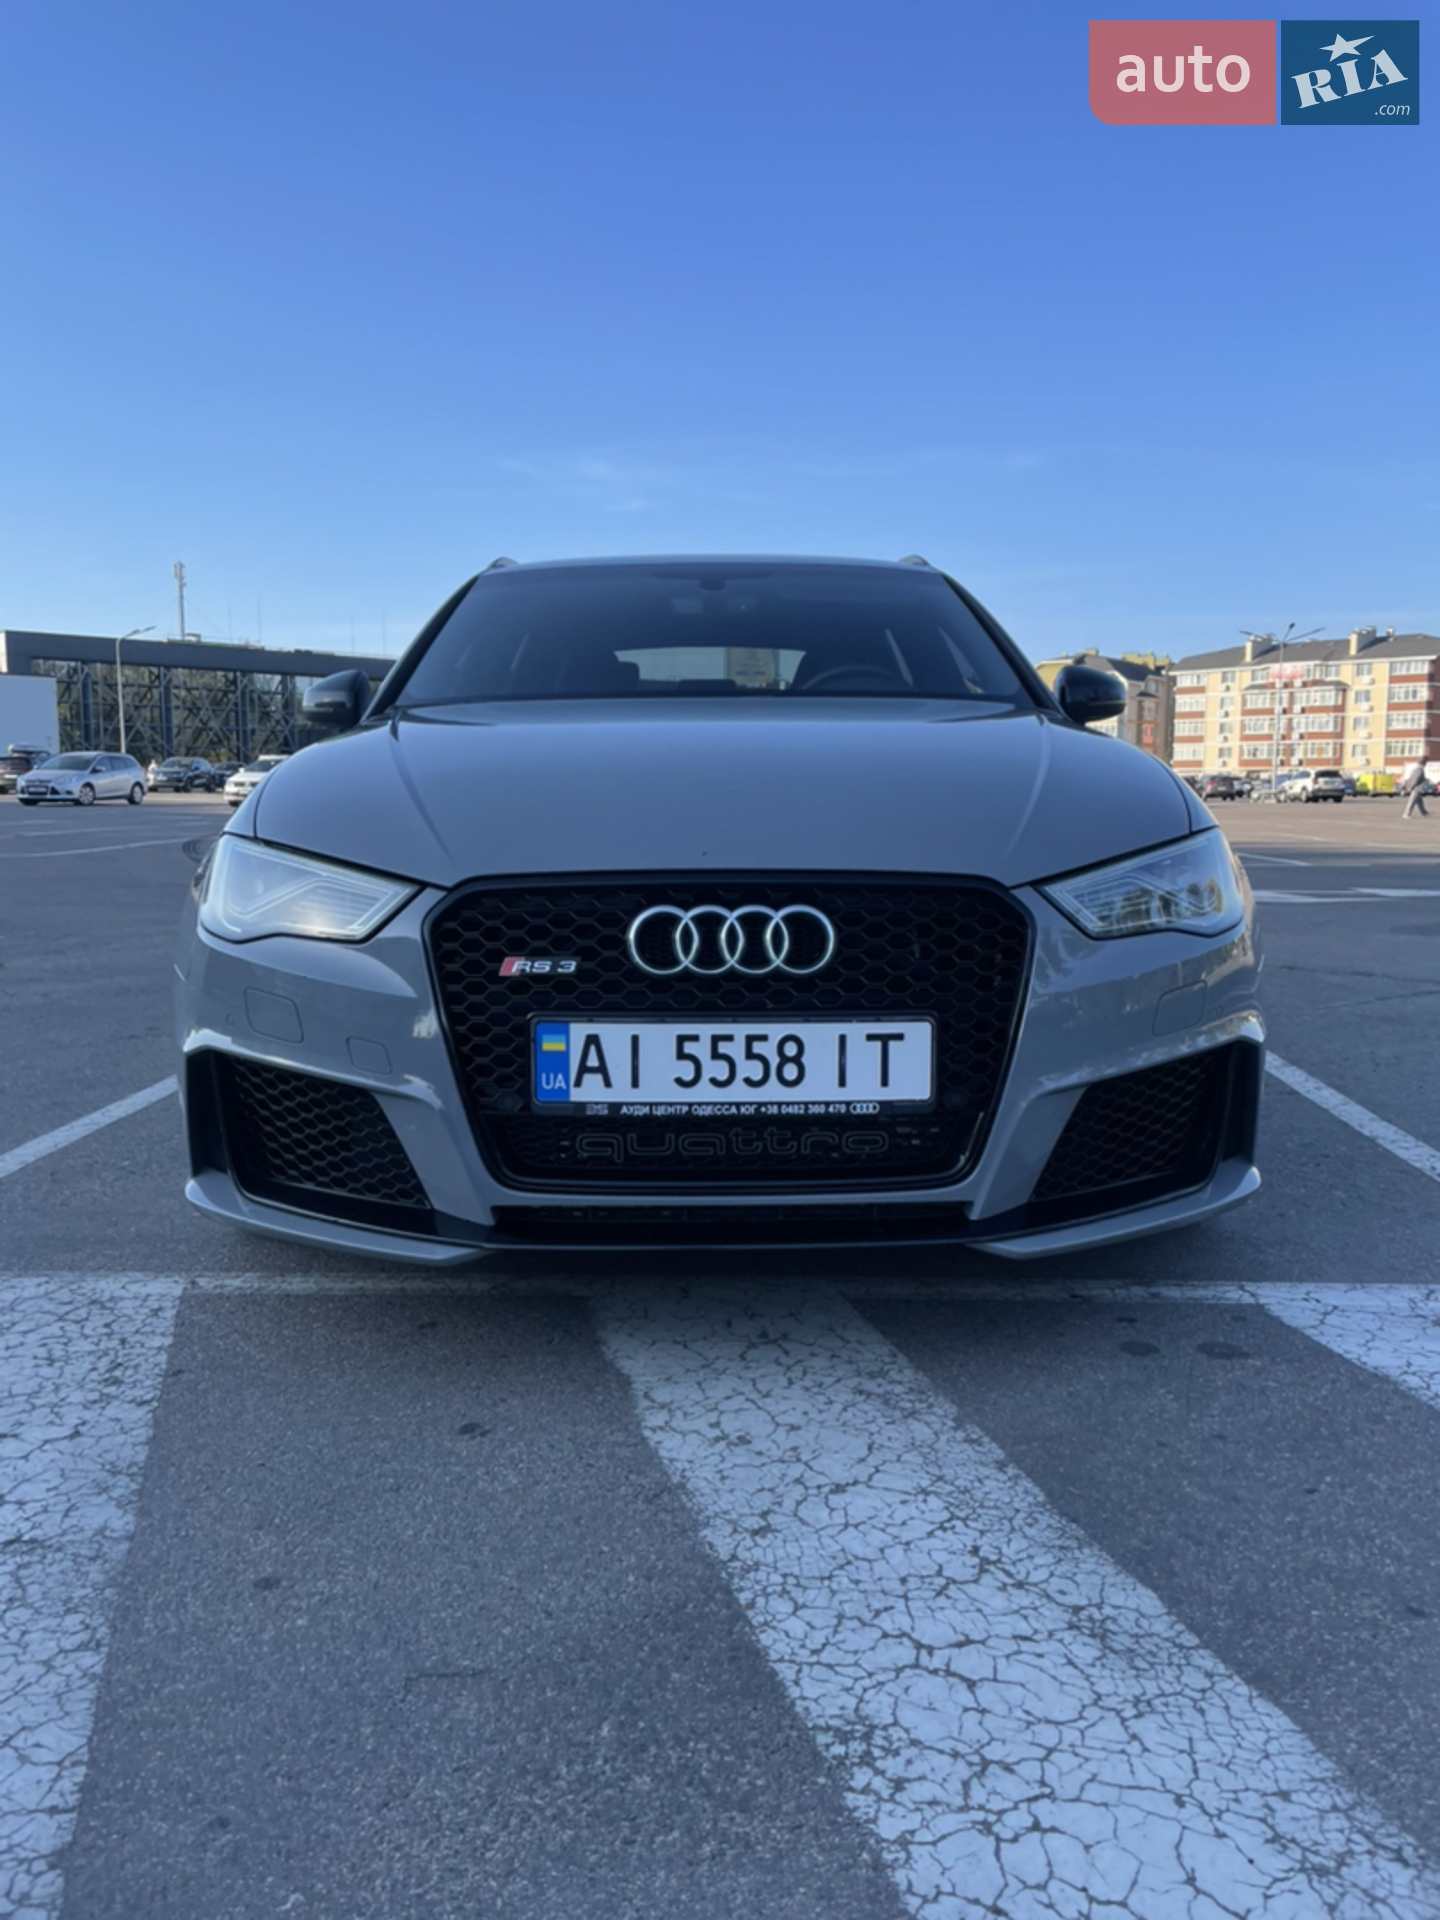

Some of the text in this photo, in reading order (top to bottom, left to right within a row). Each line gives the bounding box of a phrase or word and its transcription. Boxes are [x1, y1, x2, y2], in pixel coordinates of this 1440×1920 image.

[511, 961, 577, 973] RS 3
[573, 1033, 905, 1089] AI 5558 IT
[541, 1073, 566, 1090] UA
[620, 1103, 650, 1117] АУДИ
[652, 1103, 689, 1117] ЦЕНТР
[691, 1103, 738, 1117] ОДЕССА
[740, 1103, 758, 1116] ЮГ
[576, 1127, 888, 1163] quattro
